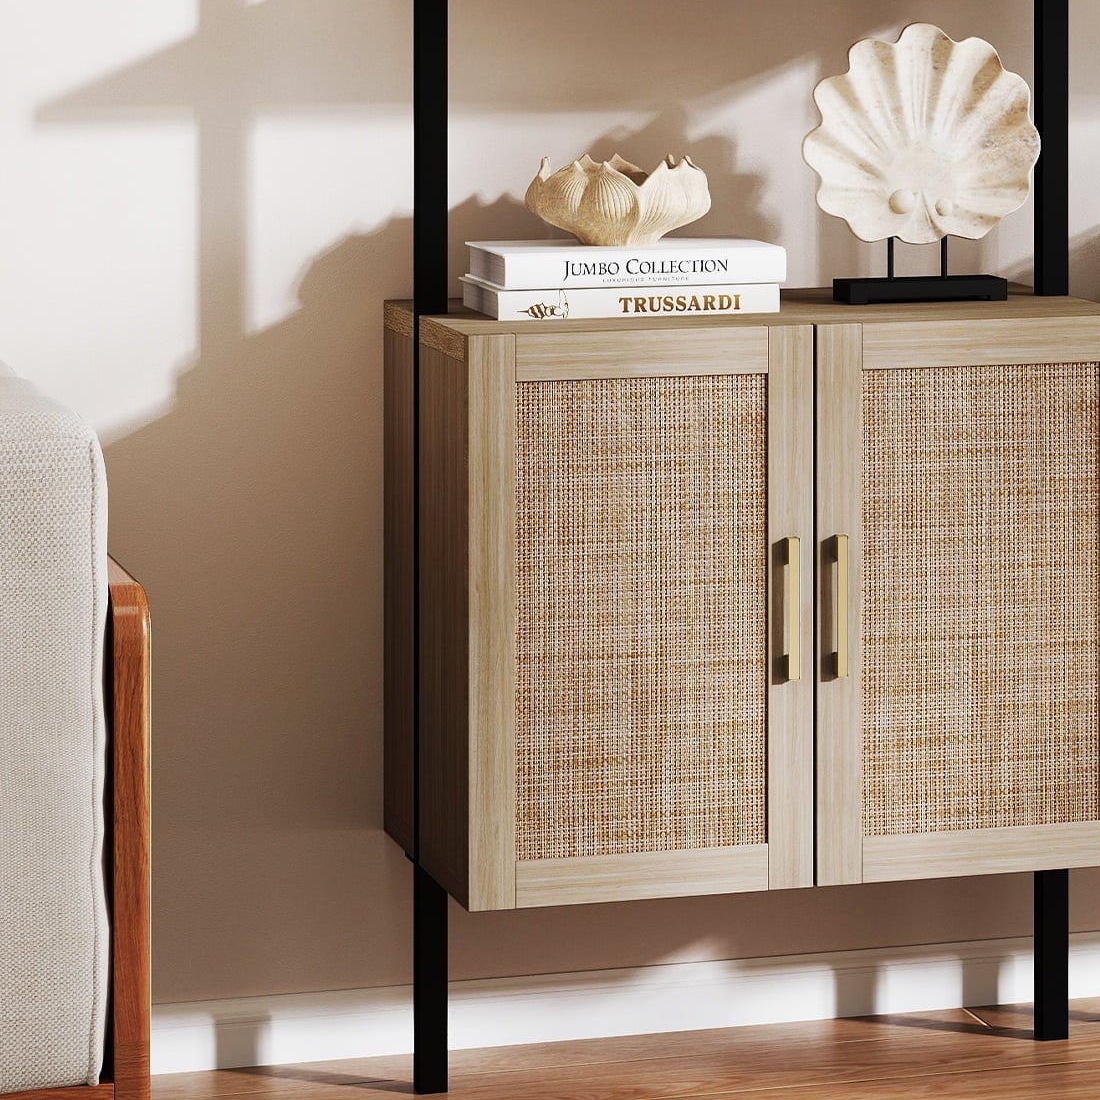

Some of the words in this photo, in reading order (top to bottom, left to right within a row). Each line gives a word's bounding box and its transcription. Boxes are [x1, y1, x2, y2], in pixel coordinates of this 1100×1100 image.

[563, 259, 620, 281] JUMBO
[625, 259, 728, 274] COLLECTION
[619, 294, 740, 313] TRUSSARDI
